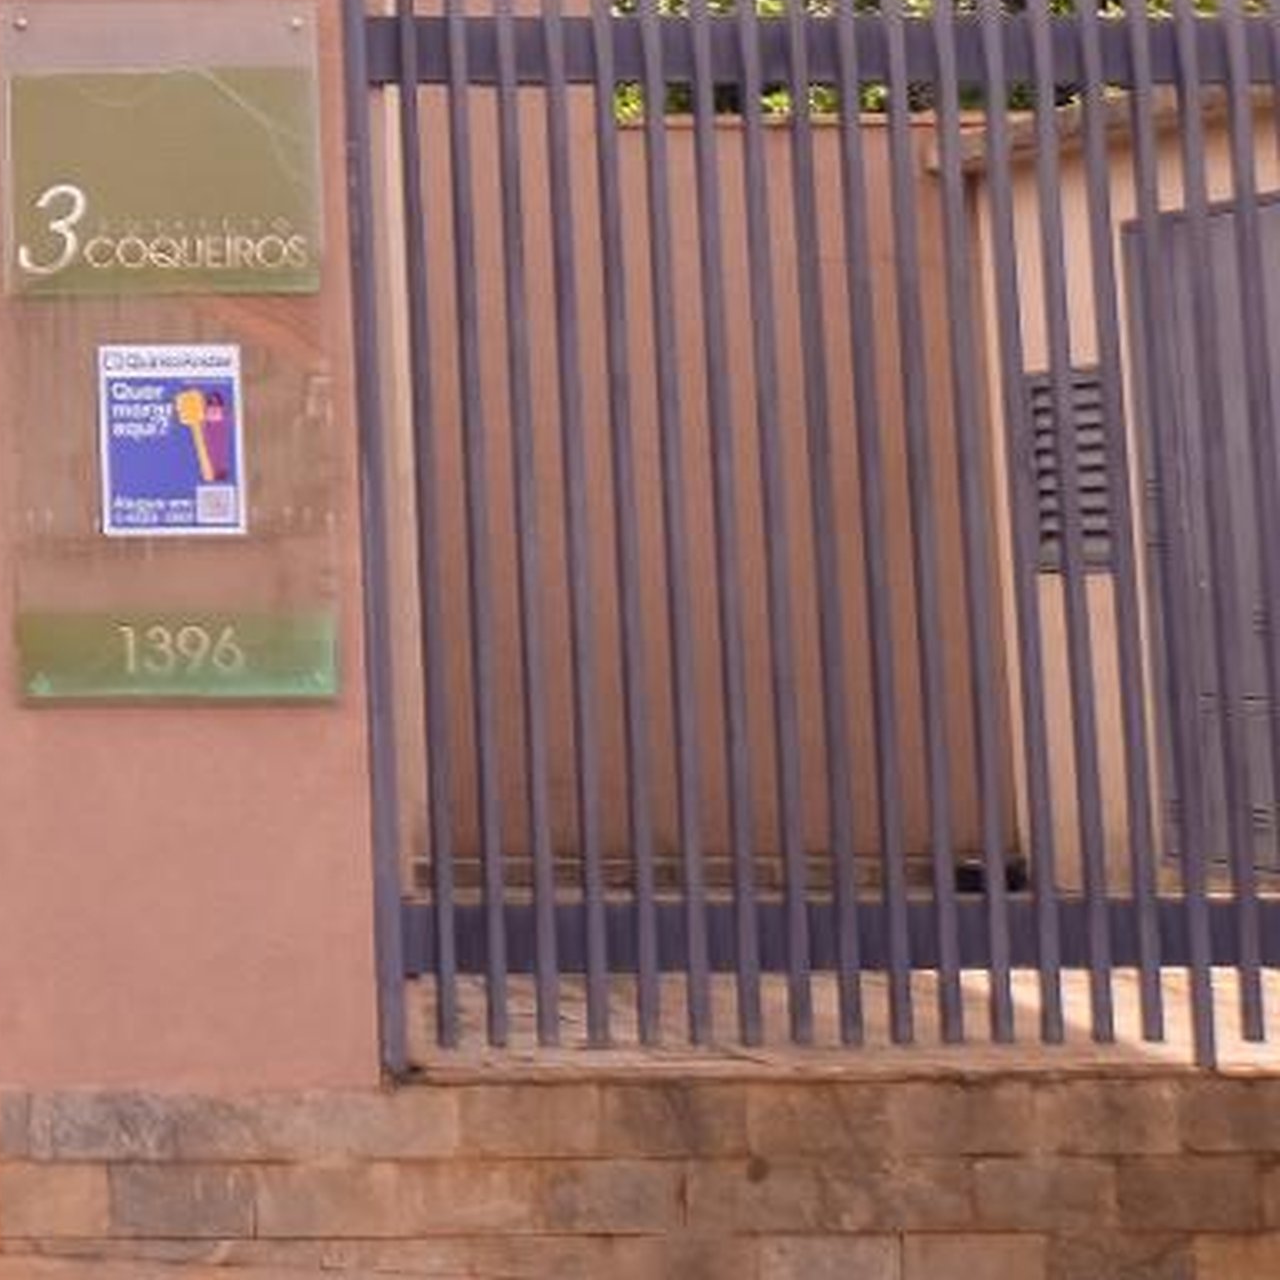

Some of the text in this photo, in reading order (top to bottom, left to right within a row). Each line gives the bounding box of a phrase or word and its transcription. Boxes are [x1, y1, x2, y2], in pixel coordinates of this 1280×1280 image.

[18, 183, 308, 274] 3 COQUEIROS
[118, 624, 244, 673] 1396
